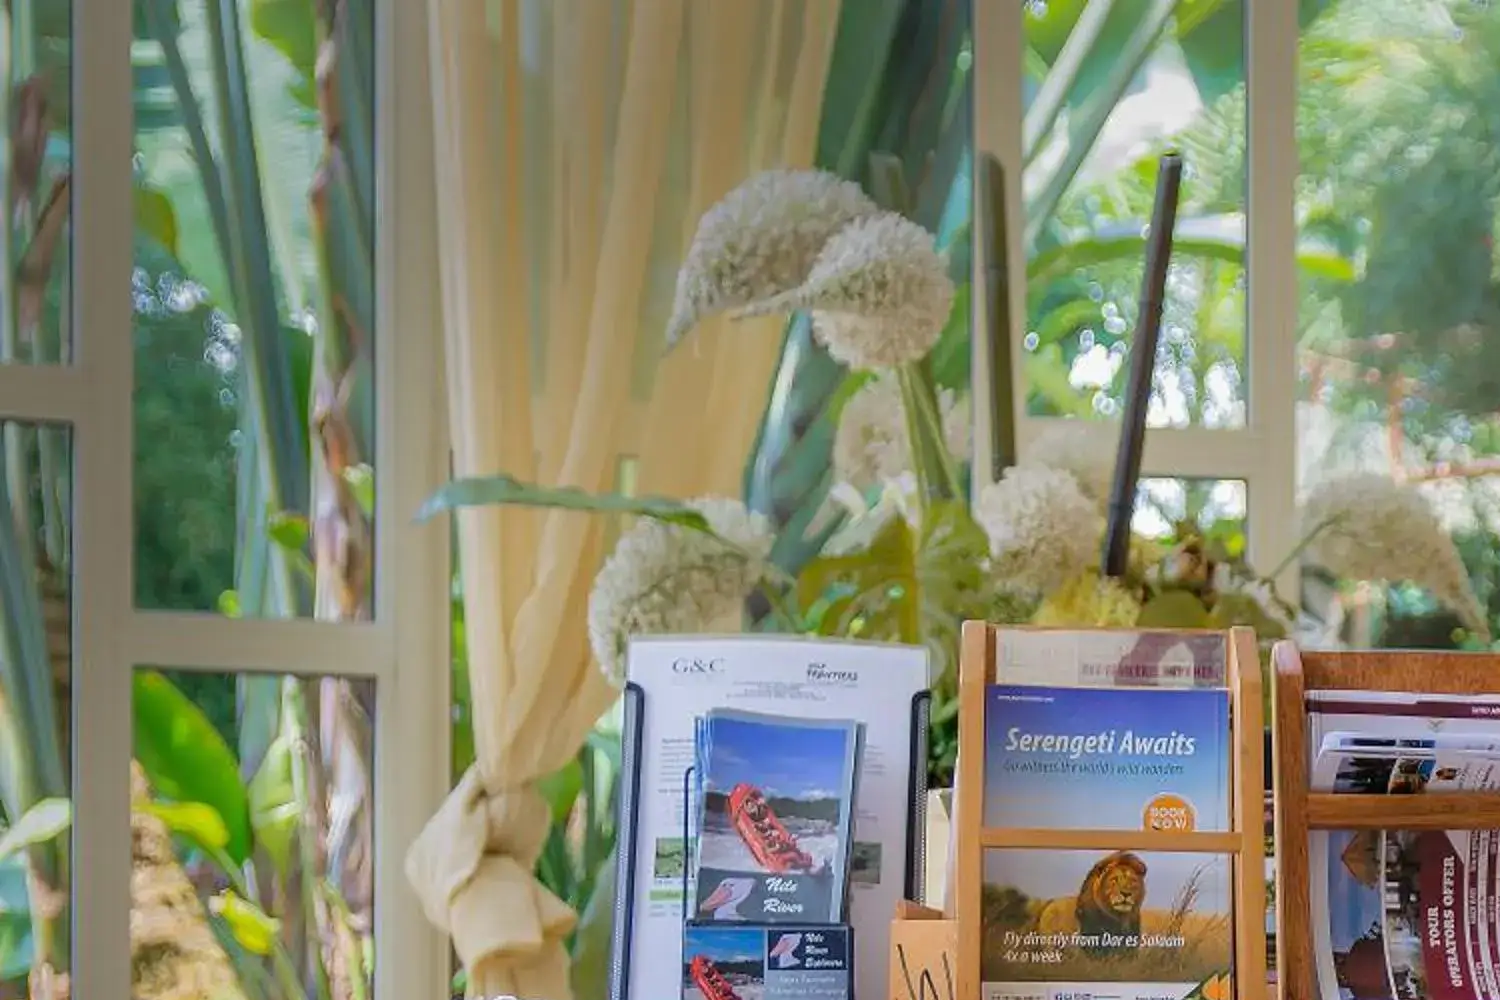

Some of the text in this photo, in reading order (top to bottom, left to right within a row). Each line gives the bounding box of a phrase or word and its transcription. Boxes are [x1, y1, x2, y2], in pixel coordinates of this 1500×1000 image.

[1005, 727, 1197, 758] Serengeti Awaits
[765, 877, 798, 893] Nile
[763, 897, 803, 913] River
[1427, 906, 1441, 948] TOUR
[1442, 855, 1463, 987] OPERATORS OFFER
[1004, 931, 1185, 949] Fly directly from Dar es Salaam
[1031, 949, 1063, 963] week
